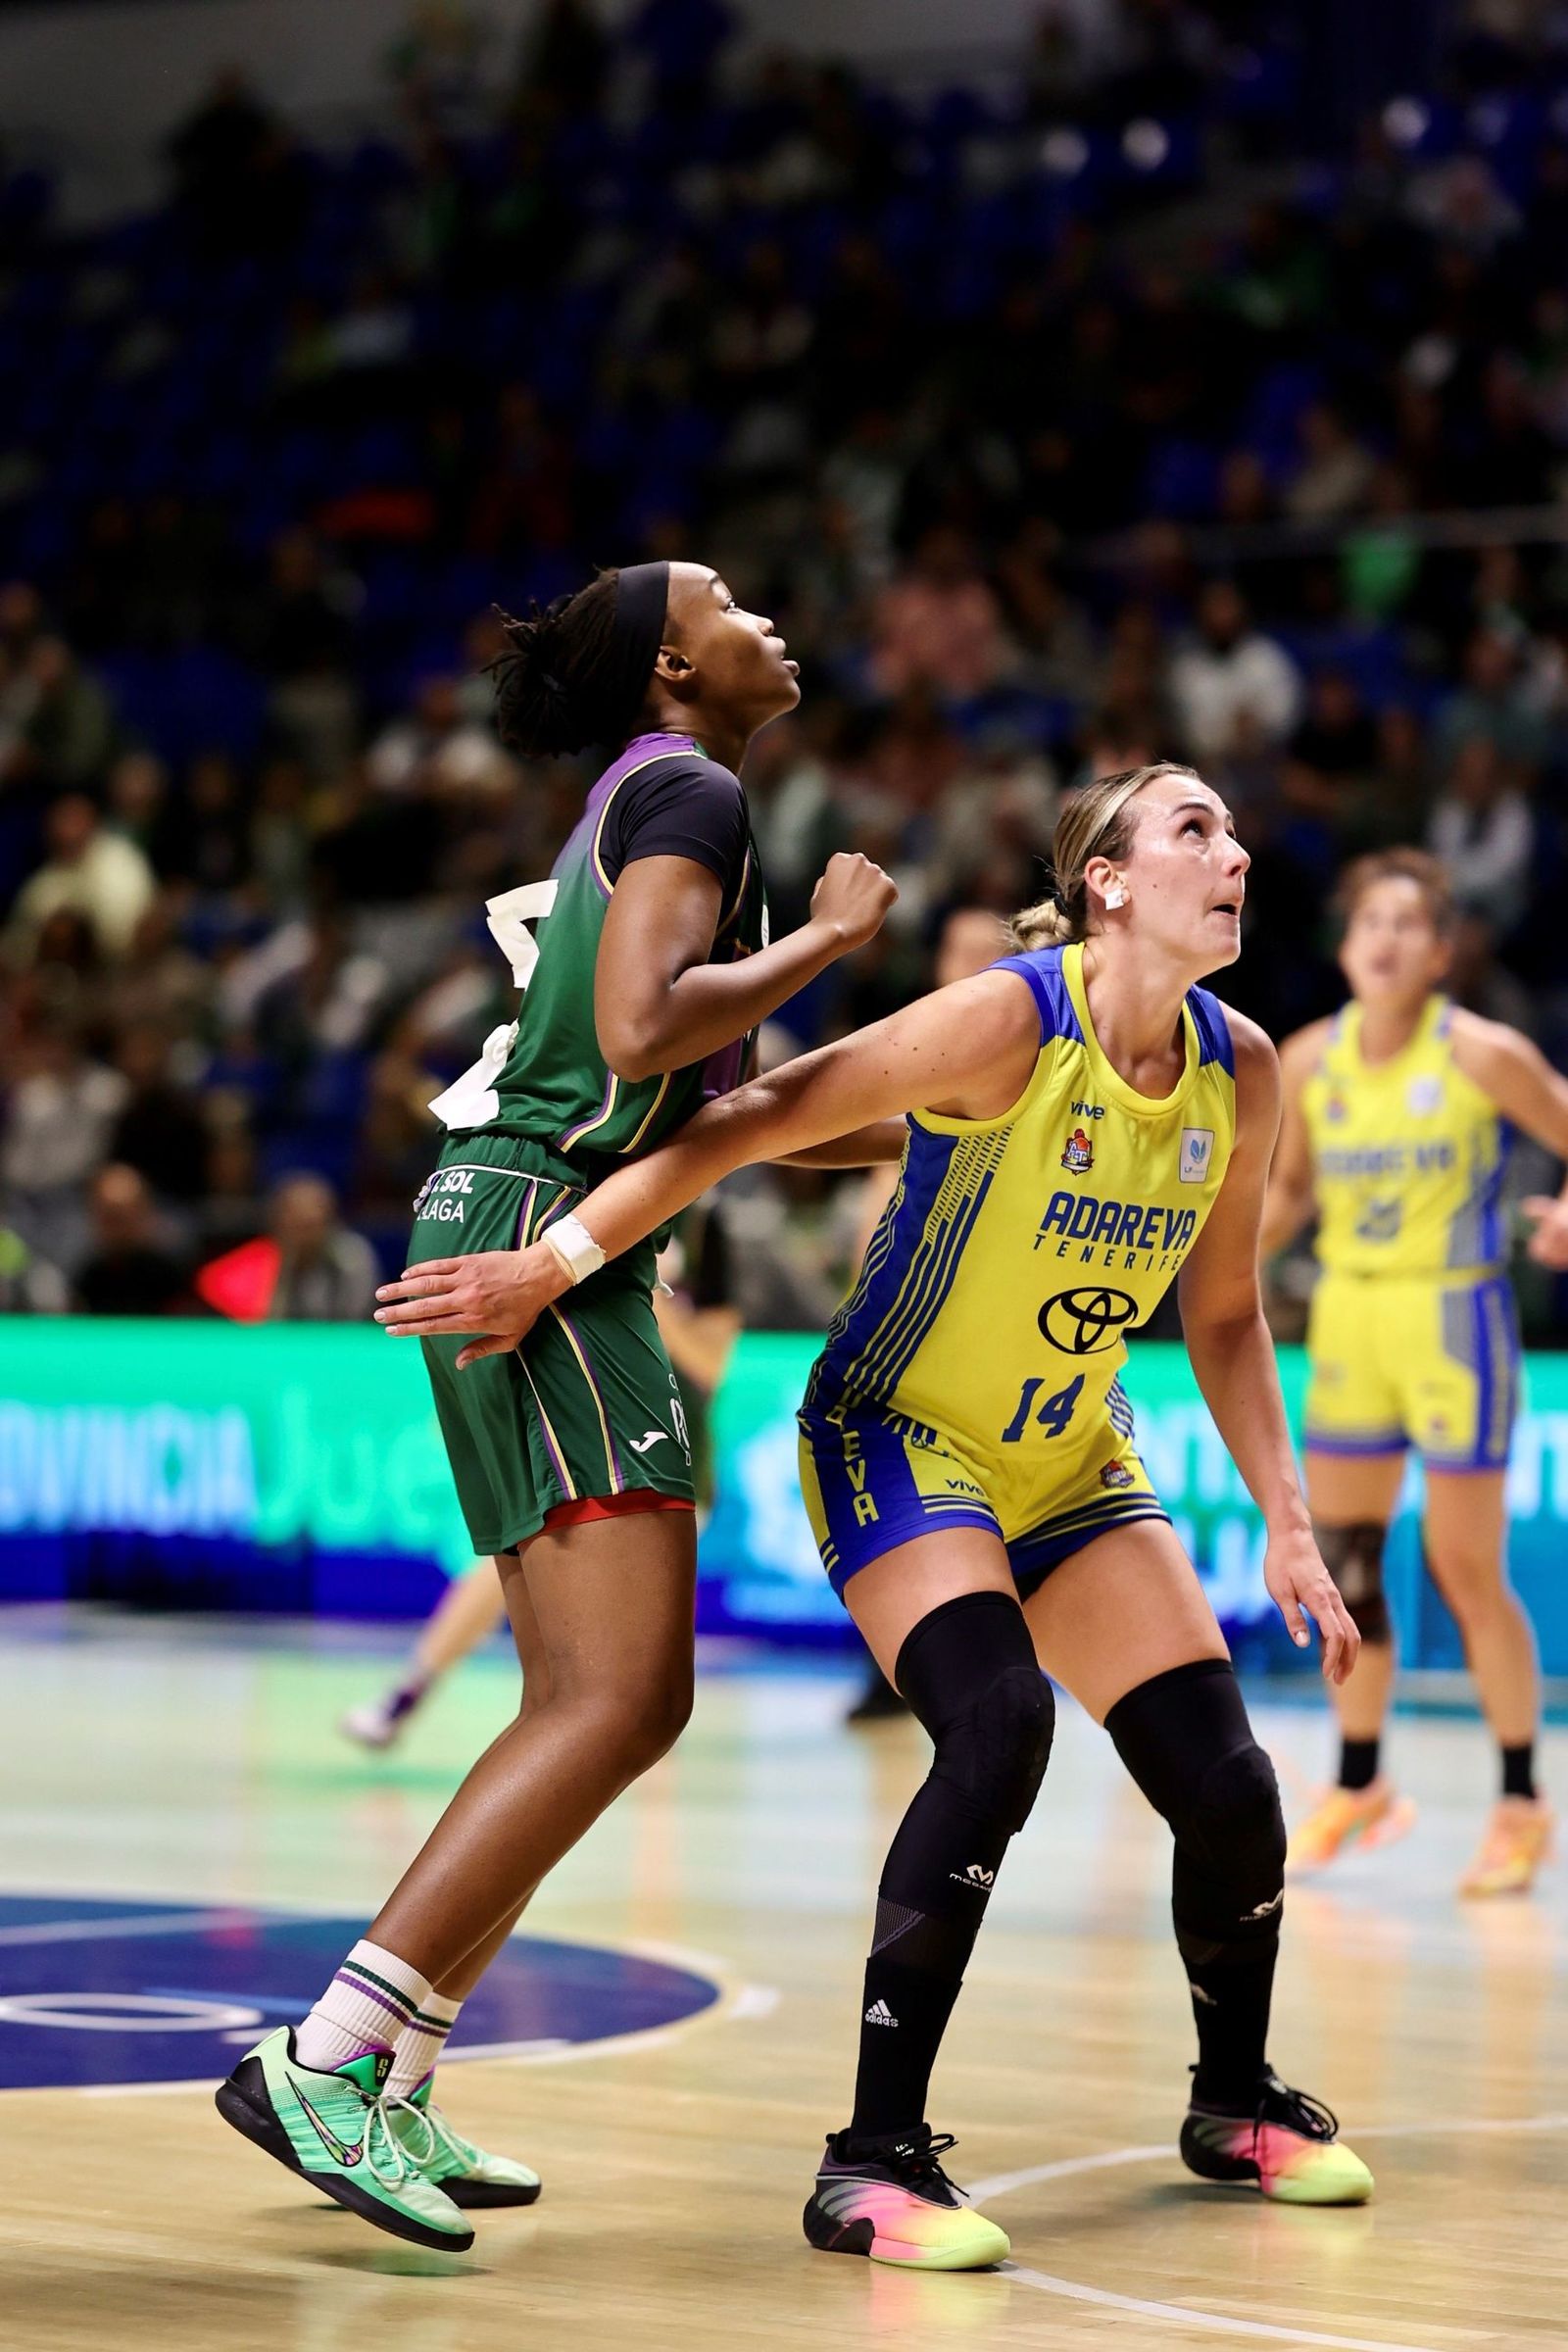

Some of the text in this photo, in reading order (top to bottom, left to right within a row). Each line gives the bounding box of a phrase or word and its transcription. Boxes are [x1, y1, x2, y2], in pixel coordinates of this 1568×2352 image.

[1070, 1100, 1105, 1120] vive
[439, 1170, 475, 1195] SOL
[416, 1199, 465, 1224] LAGA
[1040, 1191, 1197, 1251] ADAREVA
[1033, 1234, 1181, 1272] TENERIFE
[1001, 1373, 1086, 1443] 14
